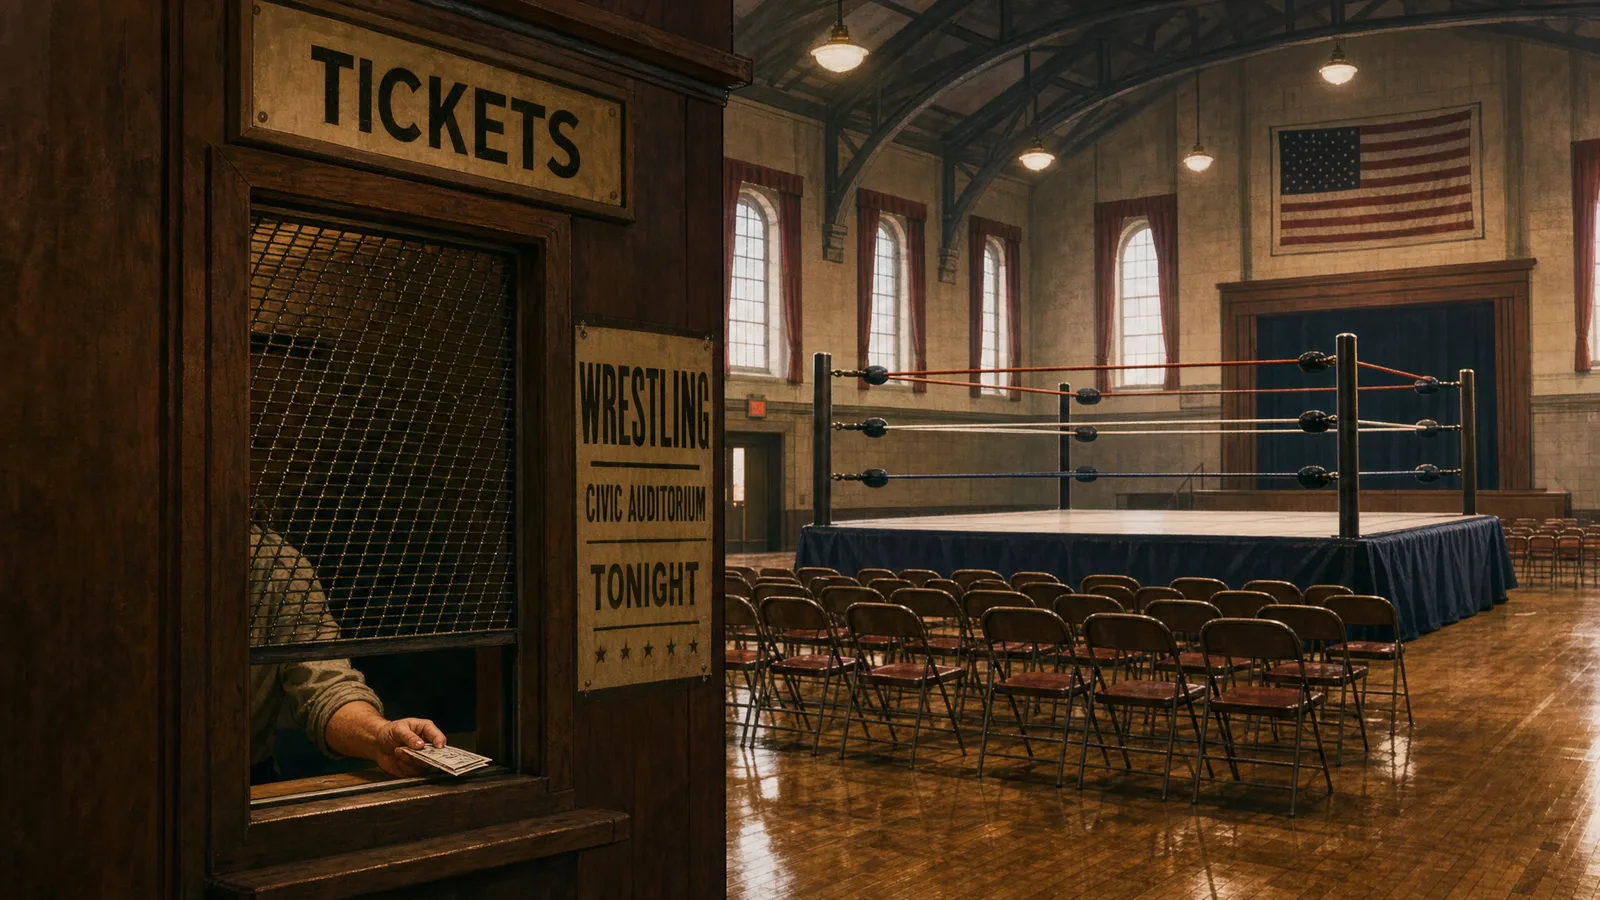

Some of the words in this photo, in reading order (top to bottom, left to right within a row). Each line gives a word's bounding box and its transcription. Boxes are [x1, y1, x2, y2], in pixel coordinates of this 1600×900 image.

[311, 44, 581, 179] TICKETS
[579, 361, 710, 450] WRESTLING
[585, 483, 623, 523] CIVIC
[627, 483, 706, 522] AUDITORIUM
[590, 561, 700, 611] TONIGHT
